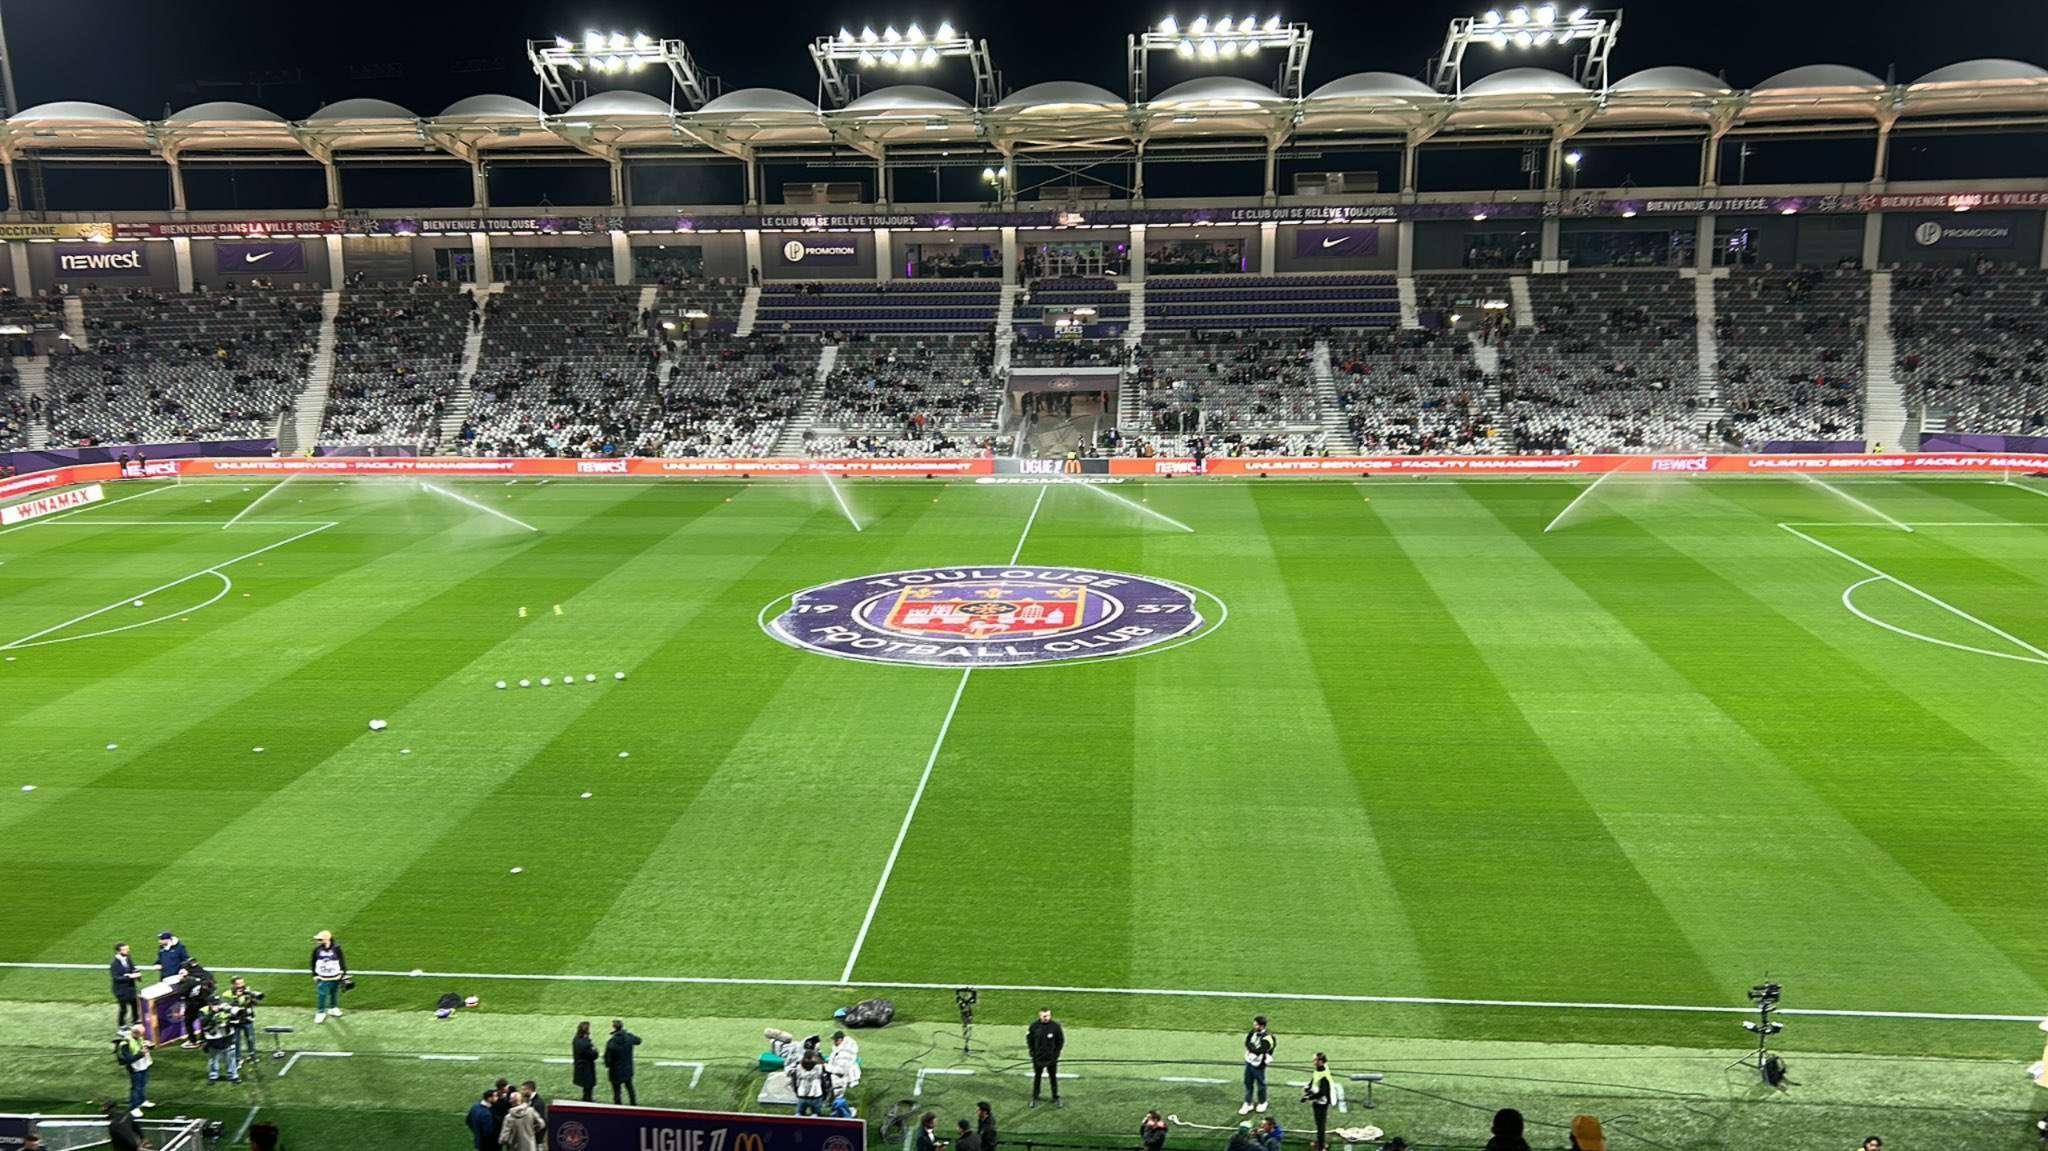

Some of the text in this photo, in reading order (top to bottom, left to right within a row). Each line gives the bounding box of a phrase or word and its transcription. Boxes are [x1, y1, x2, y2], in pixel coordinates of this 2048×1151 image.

[1647, 201, 1706, 211] BIENVENUE
[1708, 200, 1720, 210] AU
[1881, 196, 1946, 207] BIENVENUE
[1983, 195, 2000, 205] LA
[2002, 193, 2039, 205] VILLE
[1232, 206, 1397, 219] LE CLUB QUI SE RELÈVE TOUJOURS.
[423, 221, 477, 230] BIENVENUE
[488, 220, 539, 229] TOULOUSE.
[761, 216, 917, 226] LE CLUB QUI SE RELÈVE TOUJOURS.
[159, 223, 217, 234] BIENVENUE
[220, 223, 247, 233] DANS
[249, 222, 265, 232] LA
[267, 222, 294, 232] VILLE
[1943, 228, 2008, 237] PROMOTION
[806, 247, 854, 255] PROMOTION
[61, 250, 141, 269] newrest
[1020, 459, 1054, 473] LIGUE
[1469, 460, 1581, 468] MANAGEMENT
[1652, 456, 1708, 471] newrest
[1748, 459, 1827, 467] UNLIMITED
[1915, 458, 1989, 466] FACILITY
[17, 490, 89, 518] WINAMAX
[866, 568, 1131, 589] TOULOUSE
[796, 603, 839, 614] 19
[1135, 603, 1189, 614] 37
[809, 623, 1155, 658] FOOTBALL CLUB
